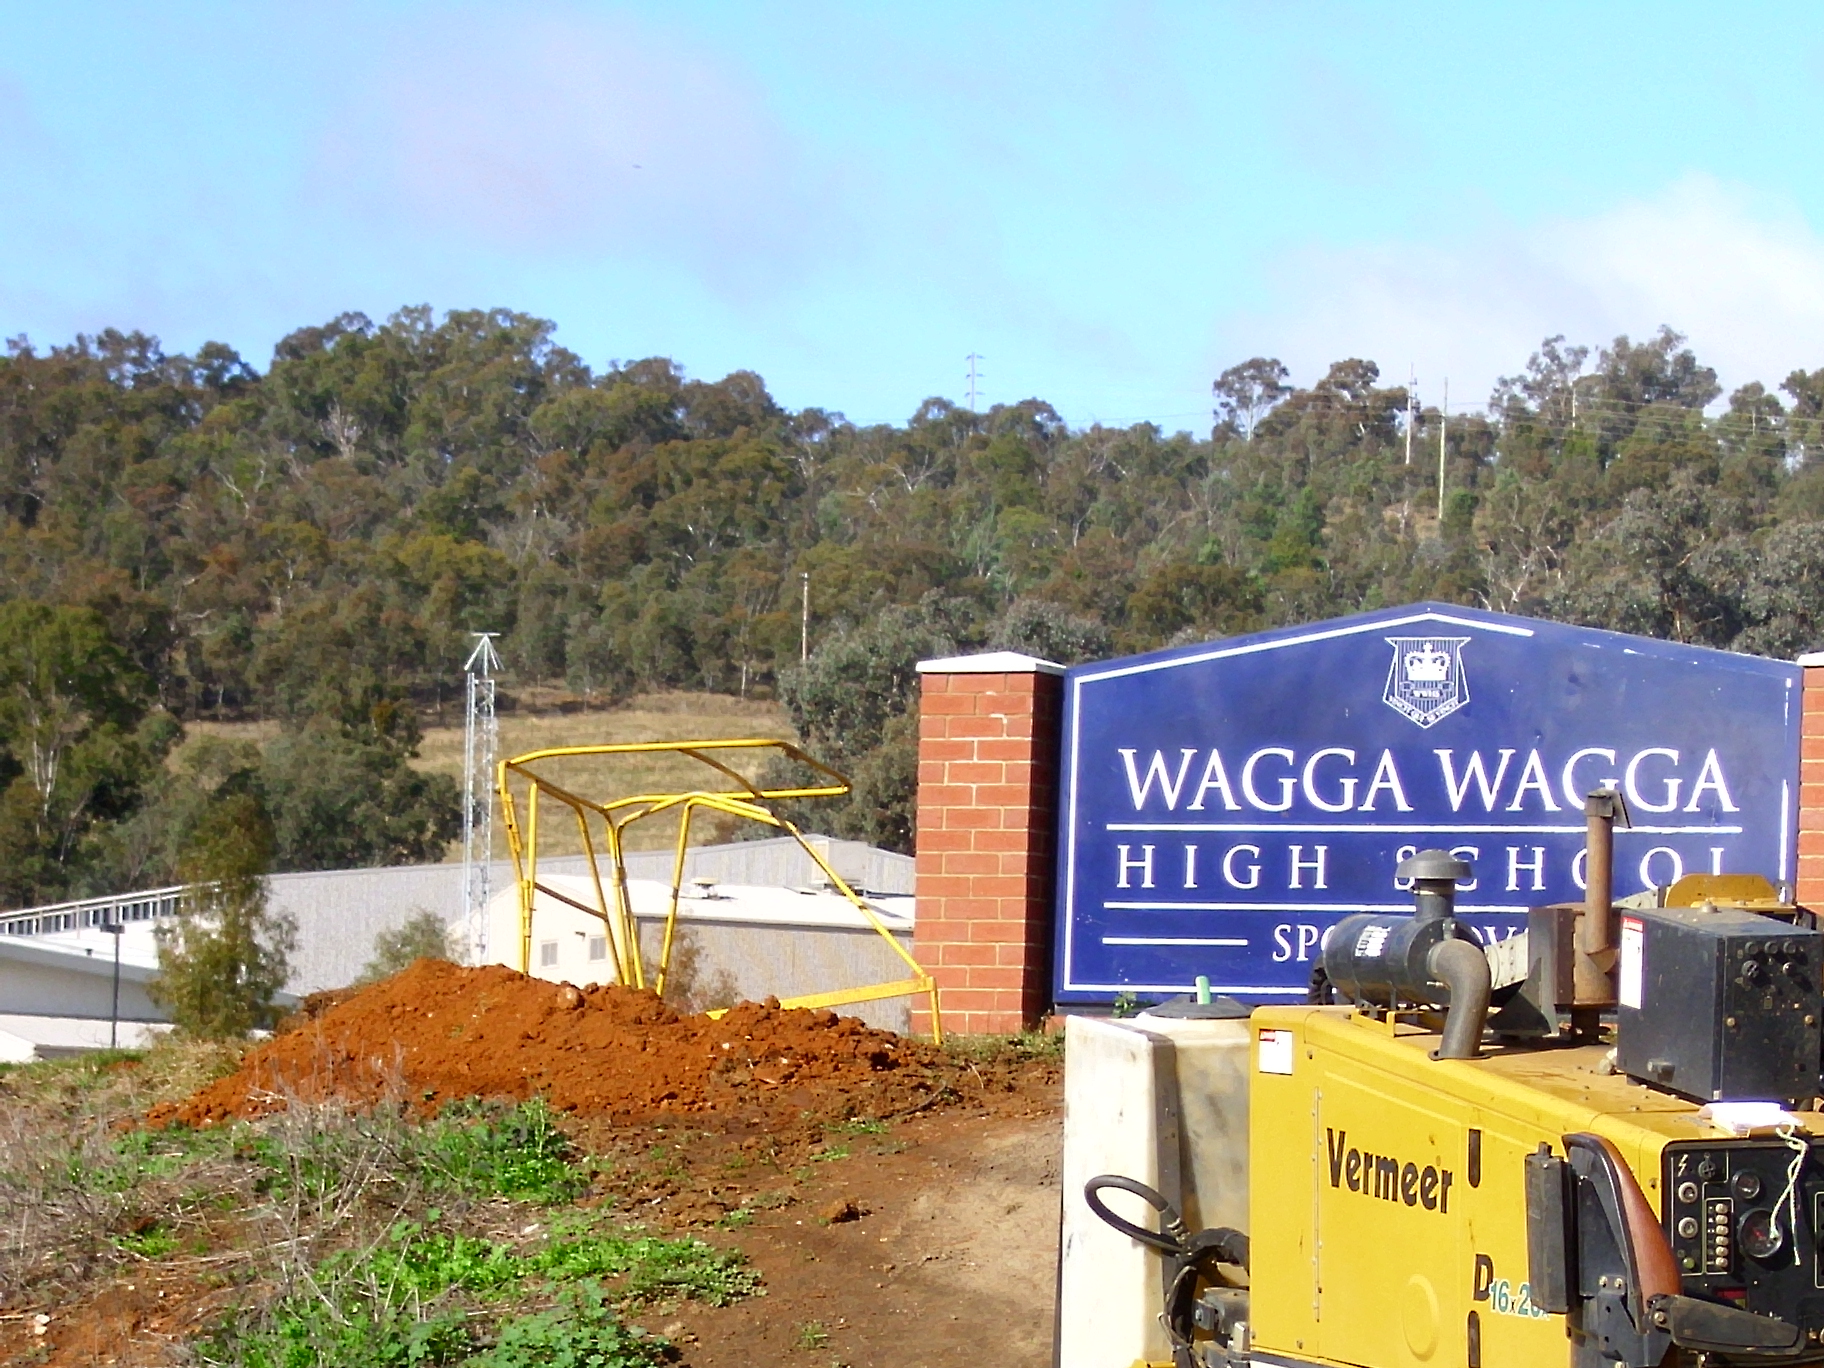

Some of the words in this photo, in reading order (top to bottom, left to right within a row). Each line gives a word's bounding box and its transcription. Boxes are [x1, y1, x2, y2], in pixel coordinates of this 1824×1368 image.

[1118, 747, 1414, 812] WAGGA
[1434, 747, 1740, 812] WAGGA
[1117, 845, 1328, 889] HIGH
[1326, 1127, 1453, 1215] Vermeer
